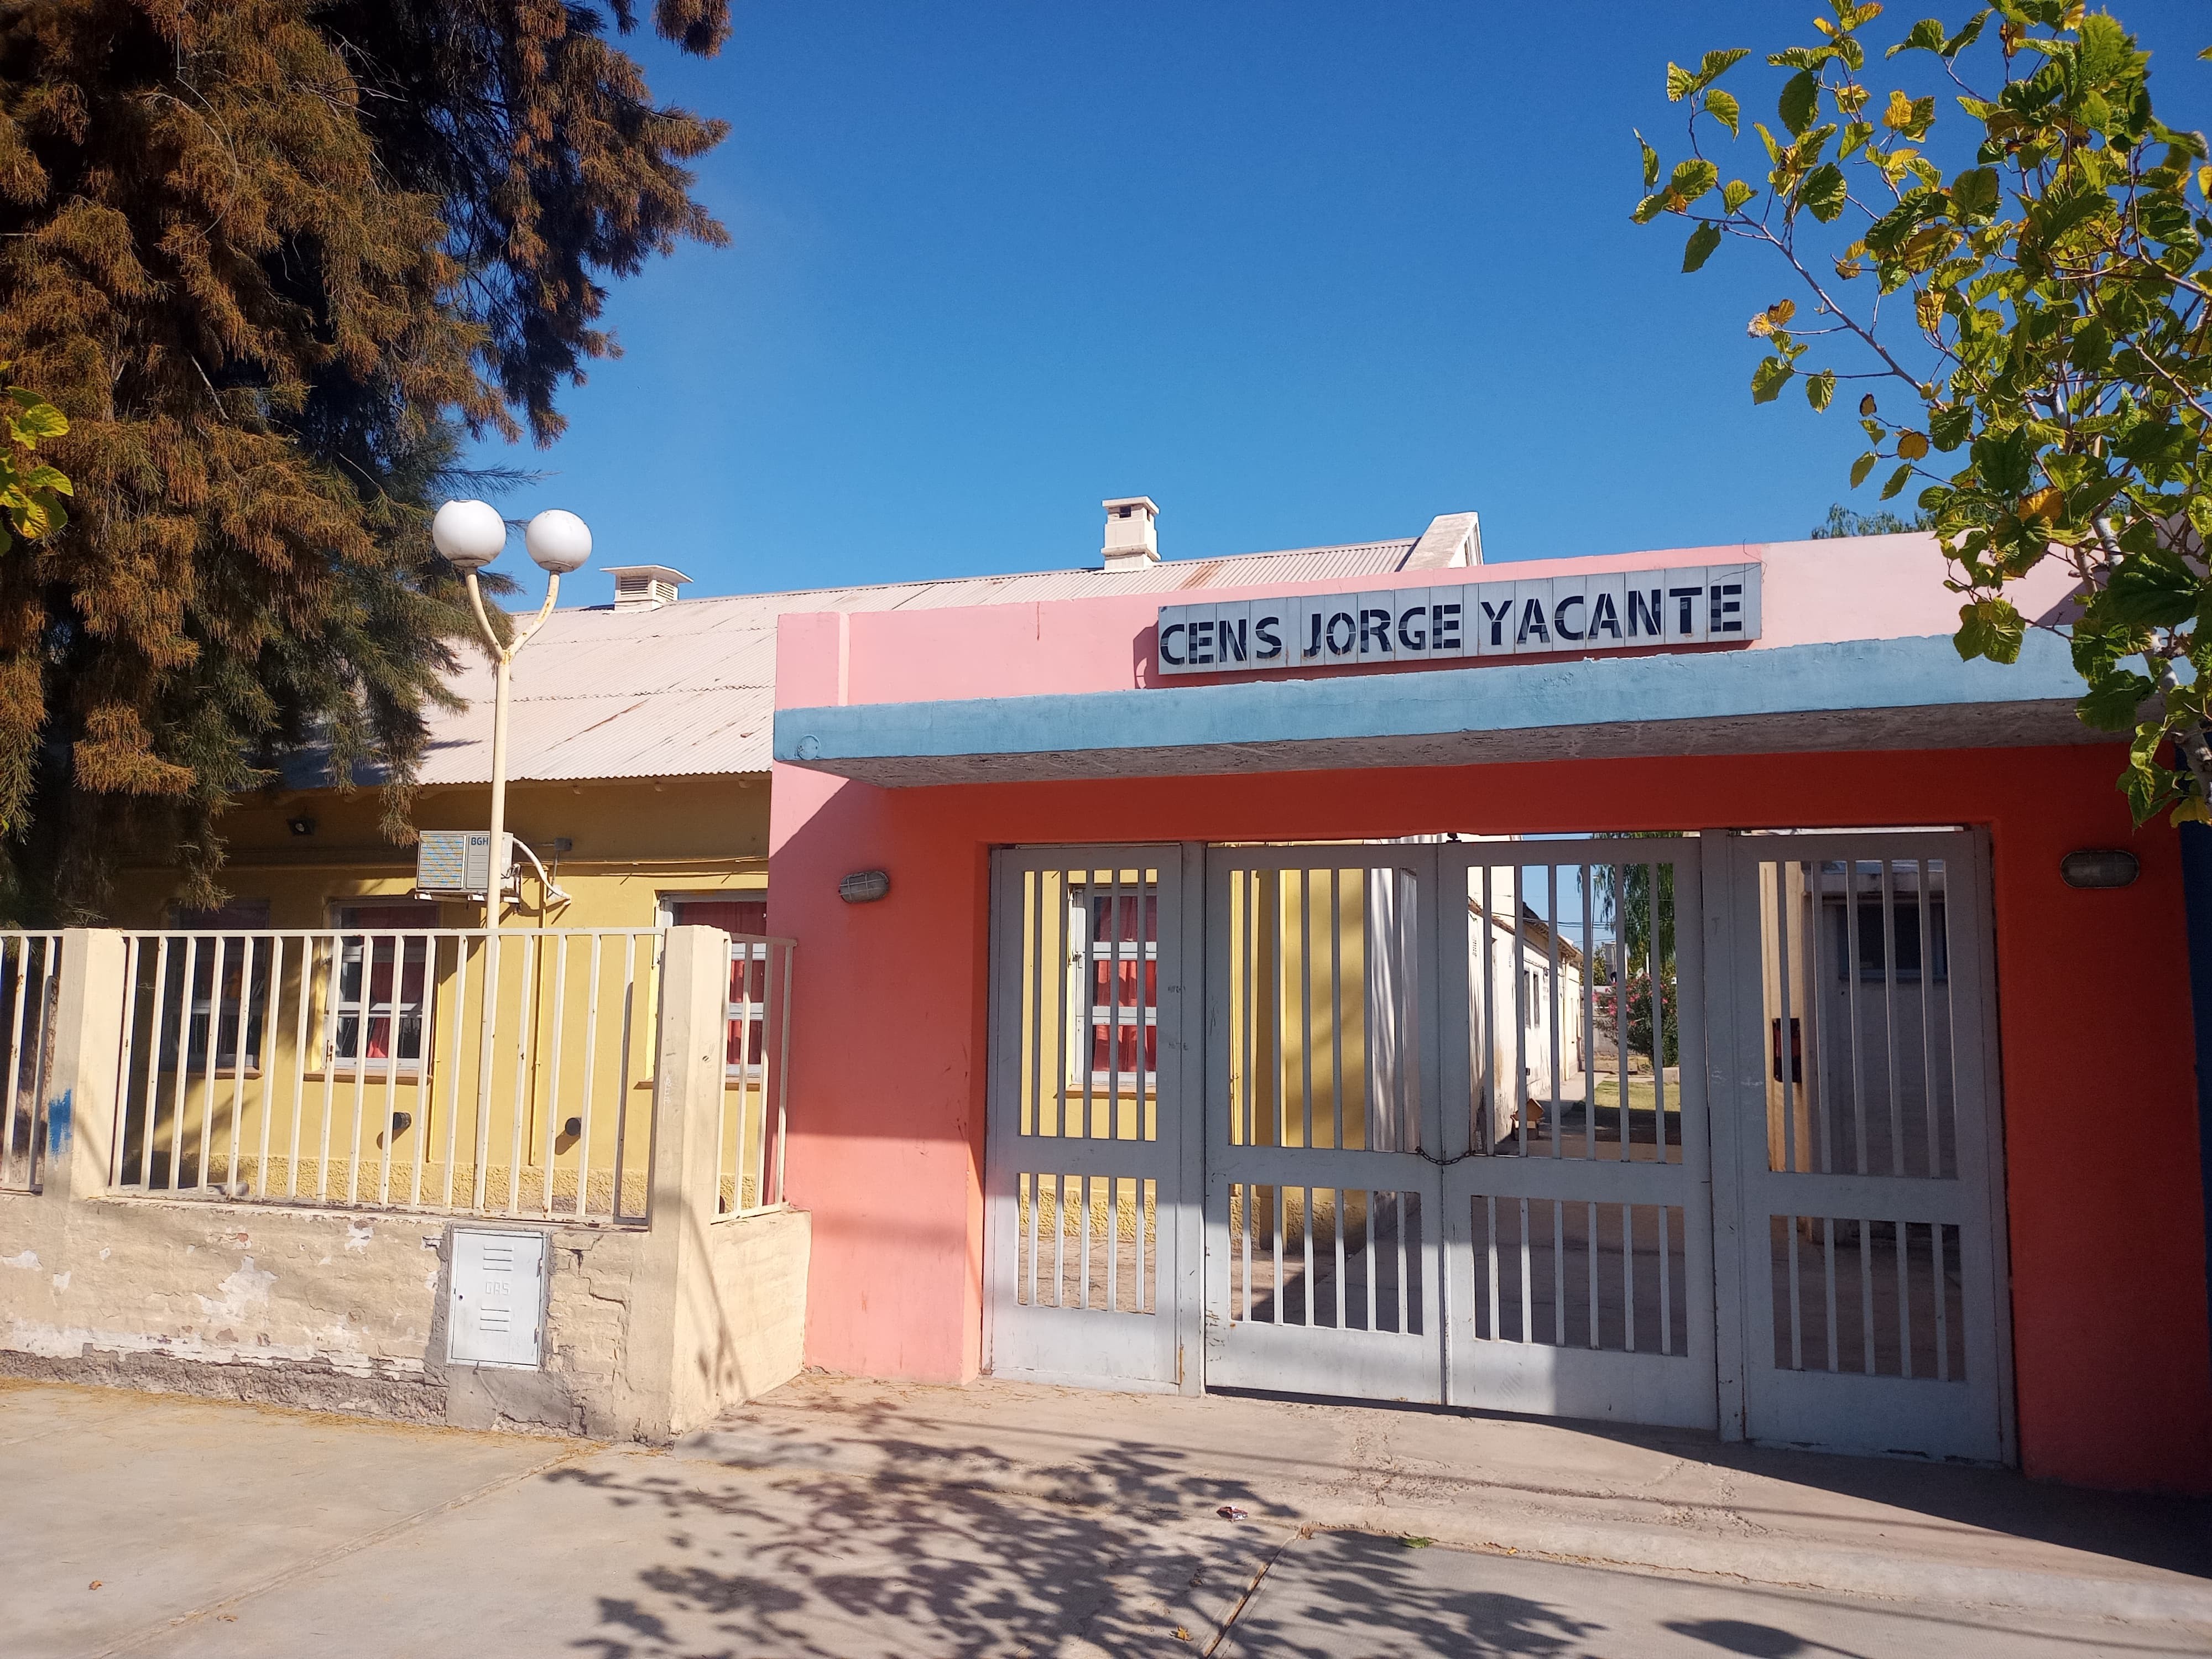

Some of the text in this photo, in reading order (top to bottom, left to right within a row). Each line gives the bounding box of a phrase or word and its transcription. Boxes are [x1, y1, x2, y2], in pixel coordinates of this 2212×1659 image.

[1160, 584, 1742, 665] CENS JORGE YACANTE
[471, 837, 488, 846] BGH
[485, 1281, 512, 1296] GAS
